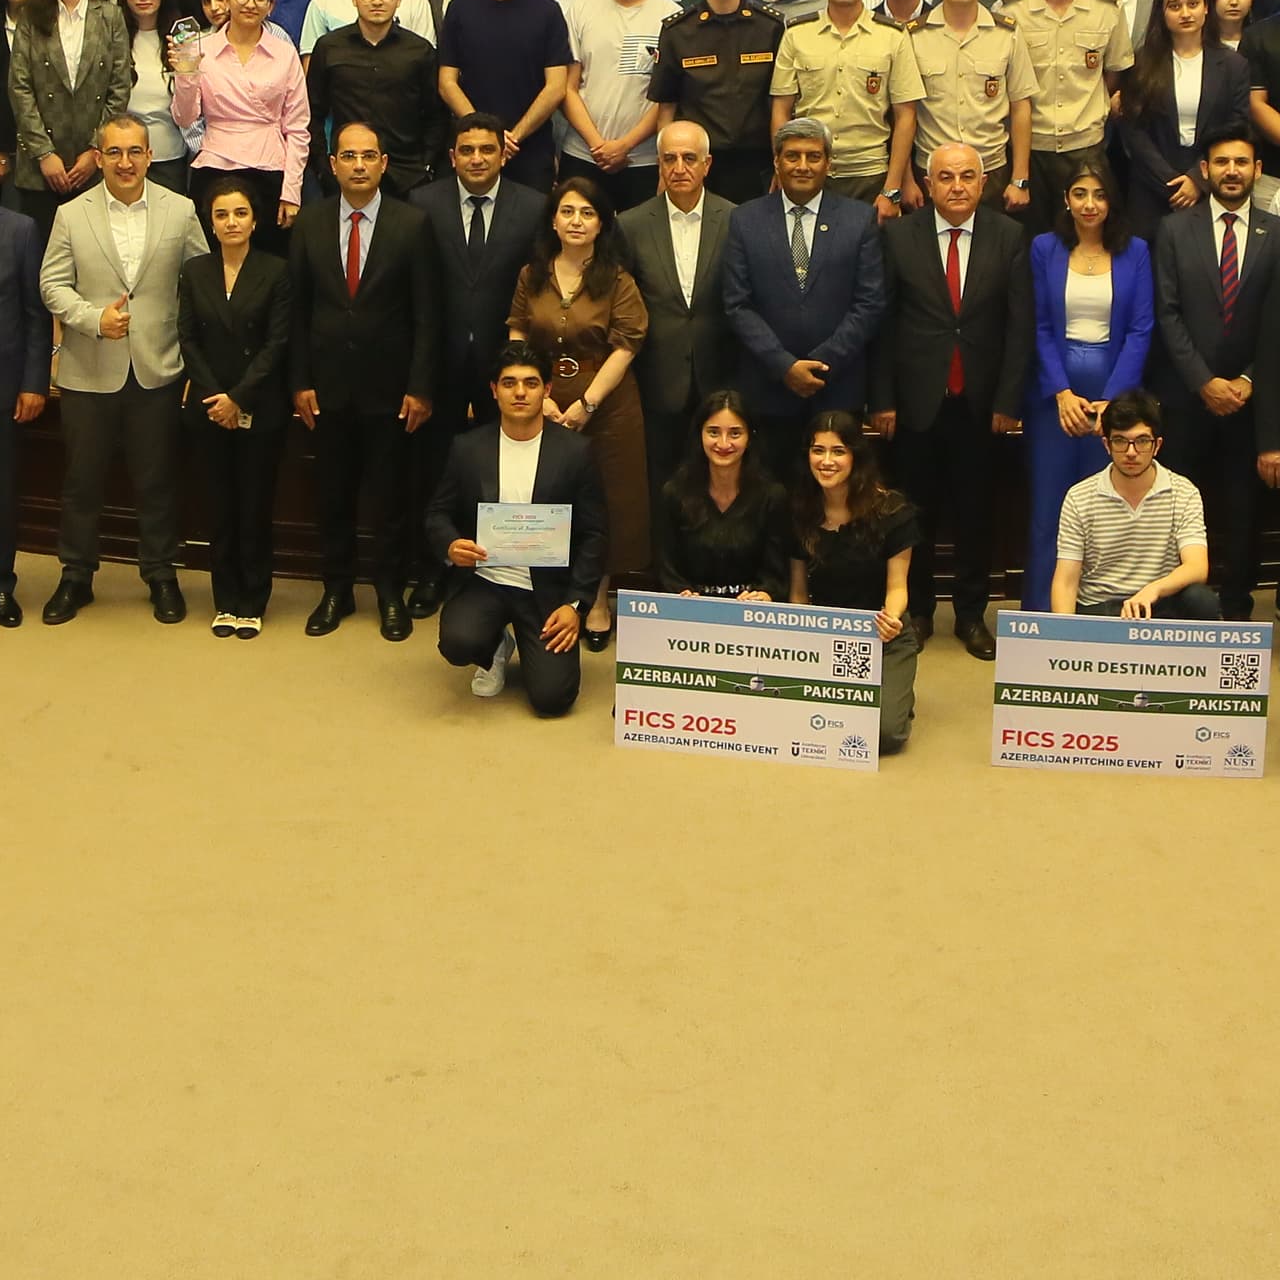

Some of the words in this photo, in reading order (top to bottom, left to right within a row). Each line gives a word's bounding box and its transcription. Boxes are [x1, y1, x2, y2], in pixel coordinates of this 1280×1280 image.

[628, 600, 658, 615] 10A
[743, 609, 828, 629] BOARDING
[832, 618, 873, 633] PASS
[1009, 621, 1040, 635] 10A
[1128, 628, 1217, 643] BOARDING
[1221, 631, 1262, 644] PASS
[667, 639, 710, 654] YOUR
[714, 643, 820, 664] DESTINATION
[622, 667, 717, 688] AZERBAIJAN
[1048, 658, 1093, 673] YOUR
[1097, 661, 1207, 678] DESTINATION
[803, 685, 874, 702] PAKISTAN
[1000, 688, 1099, 705] AZERBAIJAN
[1188, 698, 1261, 712] PAKISTAN
[624, 709, 676, 730] FICS
[682, 714, 737, 736] 2025
[623, 732, 691, 747] AZERBAIJAN
[692, 738, 743, 753] PITCHING
[744, 743, 779, 756] EVENT
[1001, 729, 1056, 748] FICS
[1062, 733, 1120, 752] 2025
[839, 747, 872, 759] NUST
[1000, 752, 1071, 764] AZERBAIJAN
[1072, 756, 1124, 767] PITCHING
[1126, 759, 1162, 769] EVENT
[1224, 758, 1257, 767] NUST
